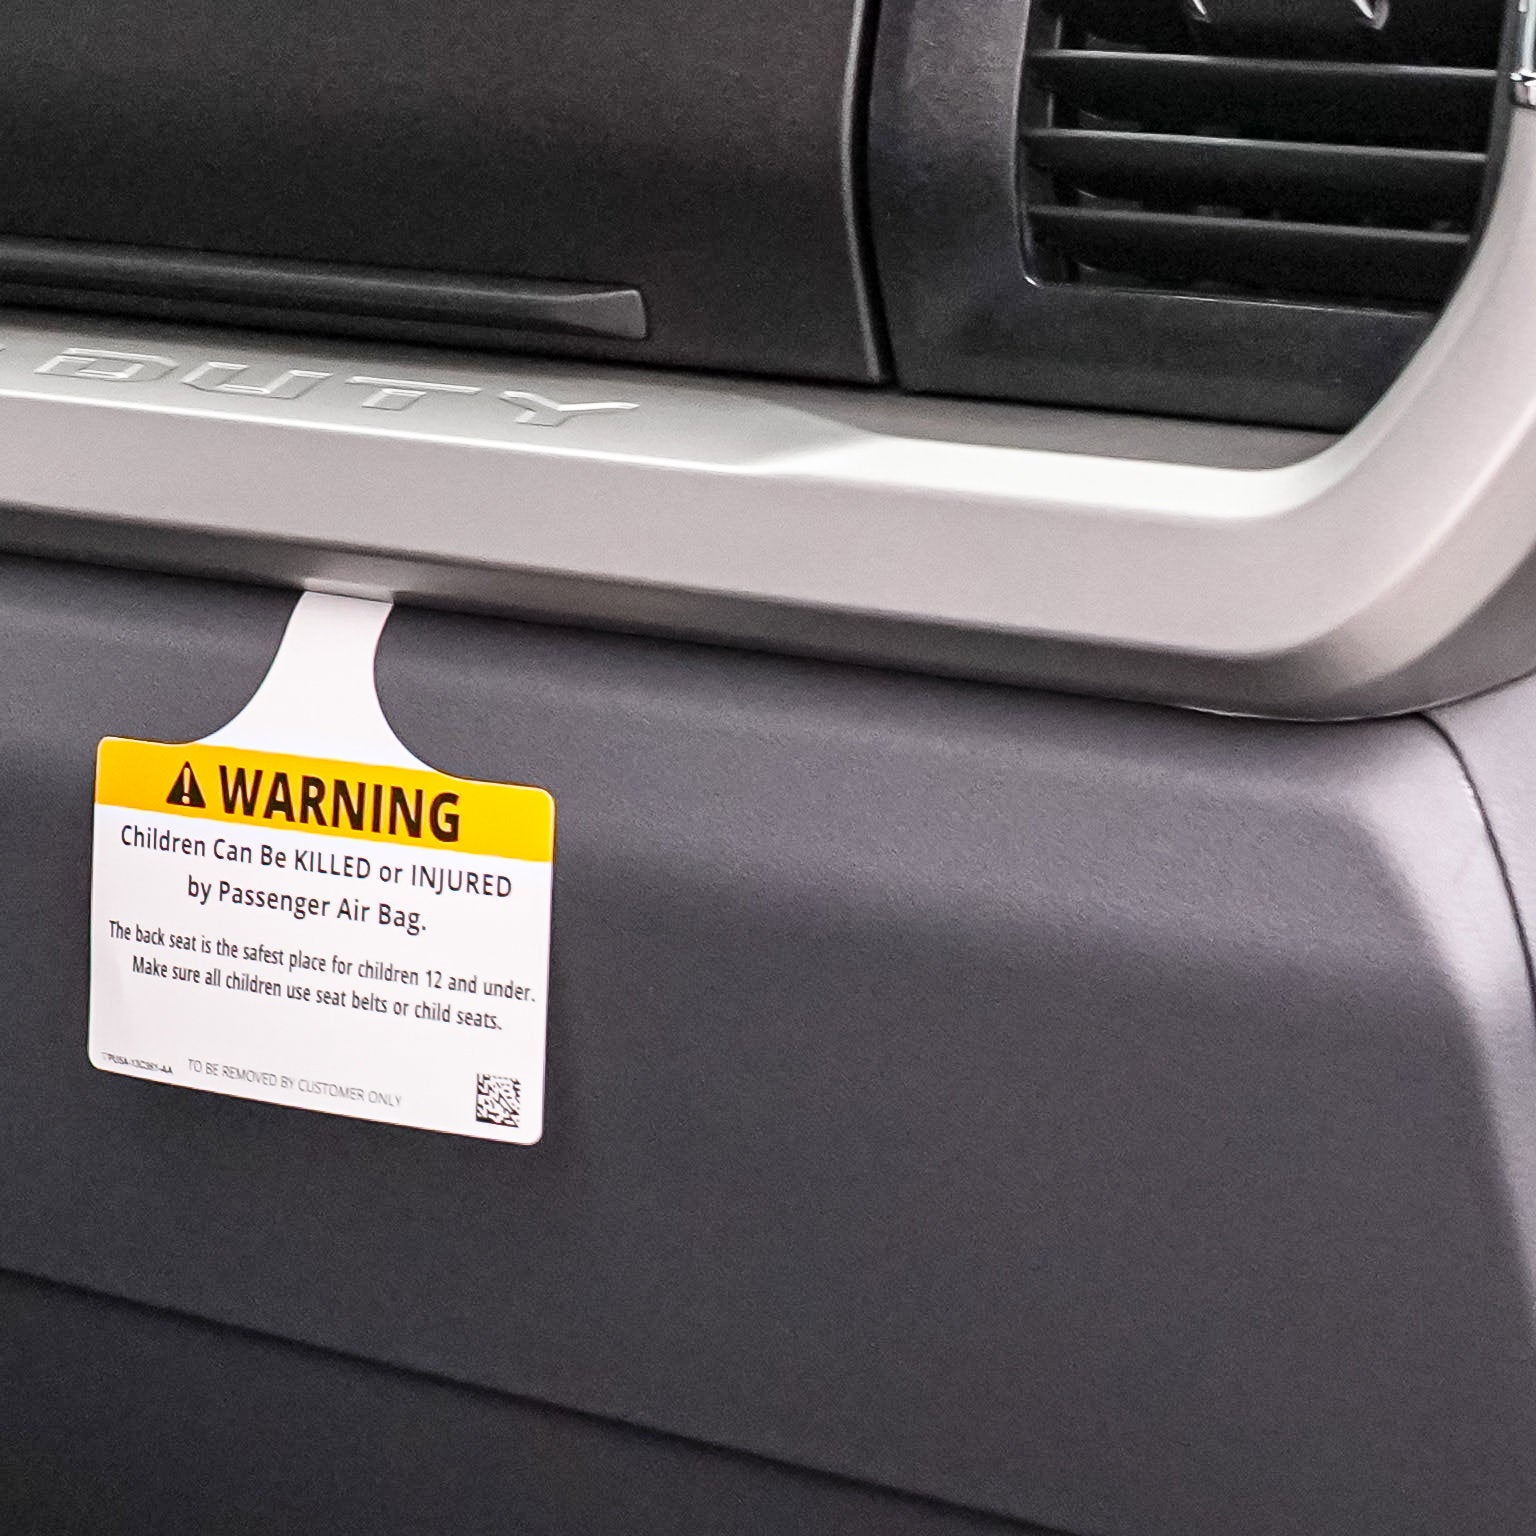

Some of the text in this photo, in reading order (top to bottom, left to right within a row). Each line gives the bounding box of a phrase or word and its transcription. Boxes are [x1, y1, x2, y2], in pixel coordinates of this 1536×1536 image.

[33, 347, 641, 427] DUTY
[218, 764, 460, 843] WARNING
[121, 824, 512, 898] Children Can Be KILLED or INJURED
[188, 874, 427, 936] by Passenger Air Bag.
[109, 919, 536, 1003] The back seat is the safest place for children 12 and under.
[132, 955, 504, 1031] Make sure all children use seat belts or child seats.
[187, 1058, 203, 1073] TO
[205, 1062, 220, 1077] BE
[221, 1065, 278, 1087] REMOVED
[280, 1075, 295, 1089] BY
[297, 1078, 365, 1102] CUSTOMER
[368, 1090, 403, 1108] ONLY
